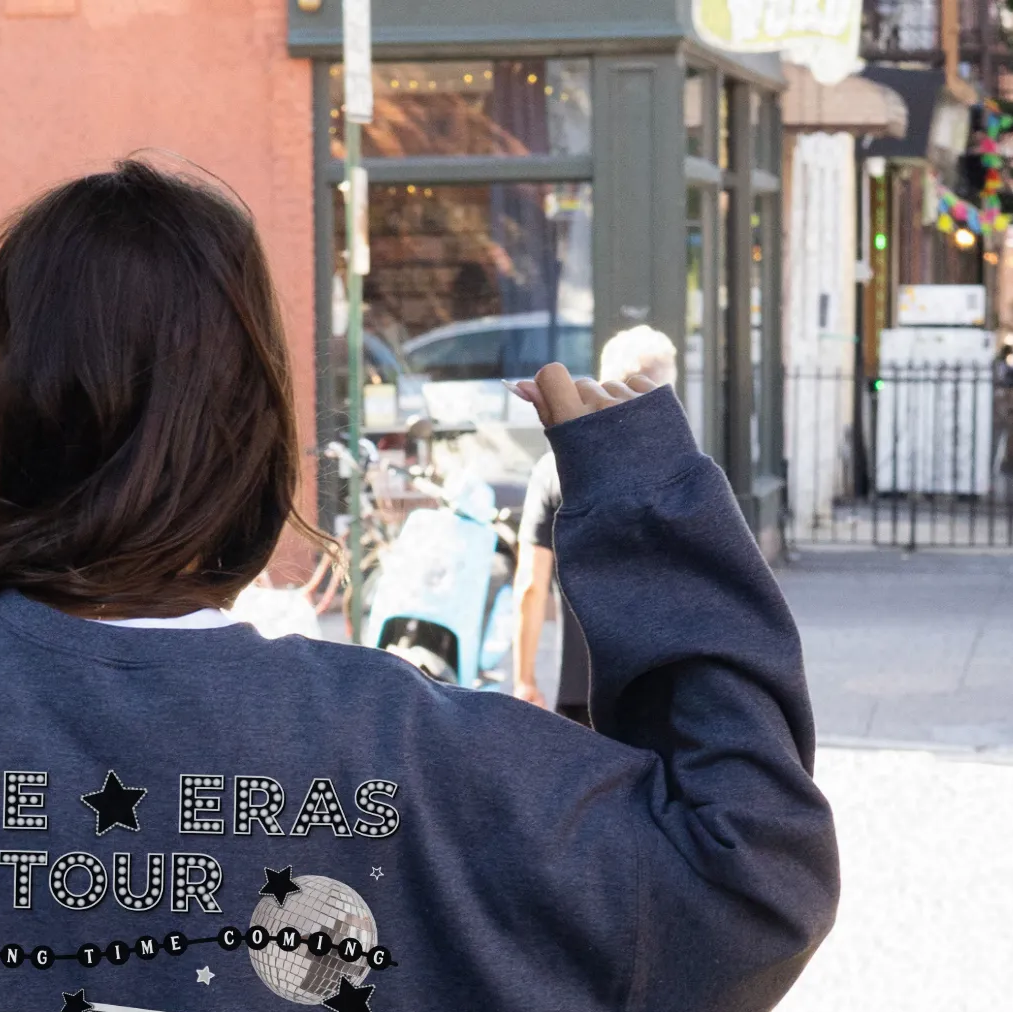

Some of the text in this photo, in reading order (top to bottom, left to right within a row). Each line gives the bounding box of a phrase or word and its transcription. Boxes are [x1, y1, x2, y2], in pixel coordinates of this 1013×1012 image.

[179, 773, 401, 838] ERAS
[84, 935, 181, 965] TIME
[224, 929, 386, 966] COMING
